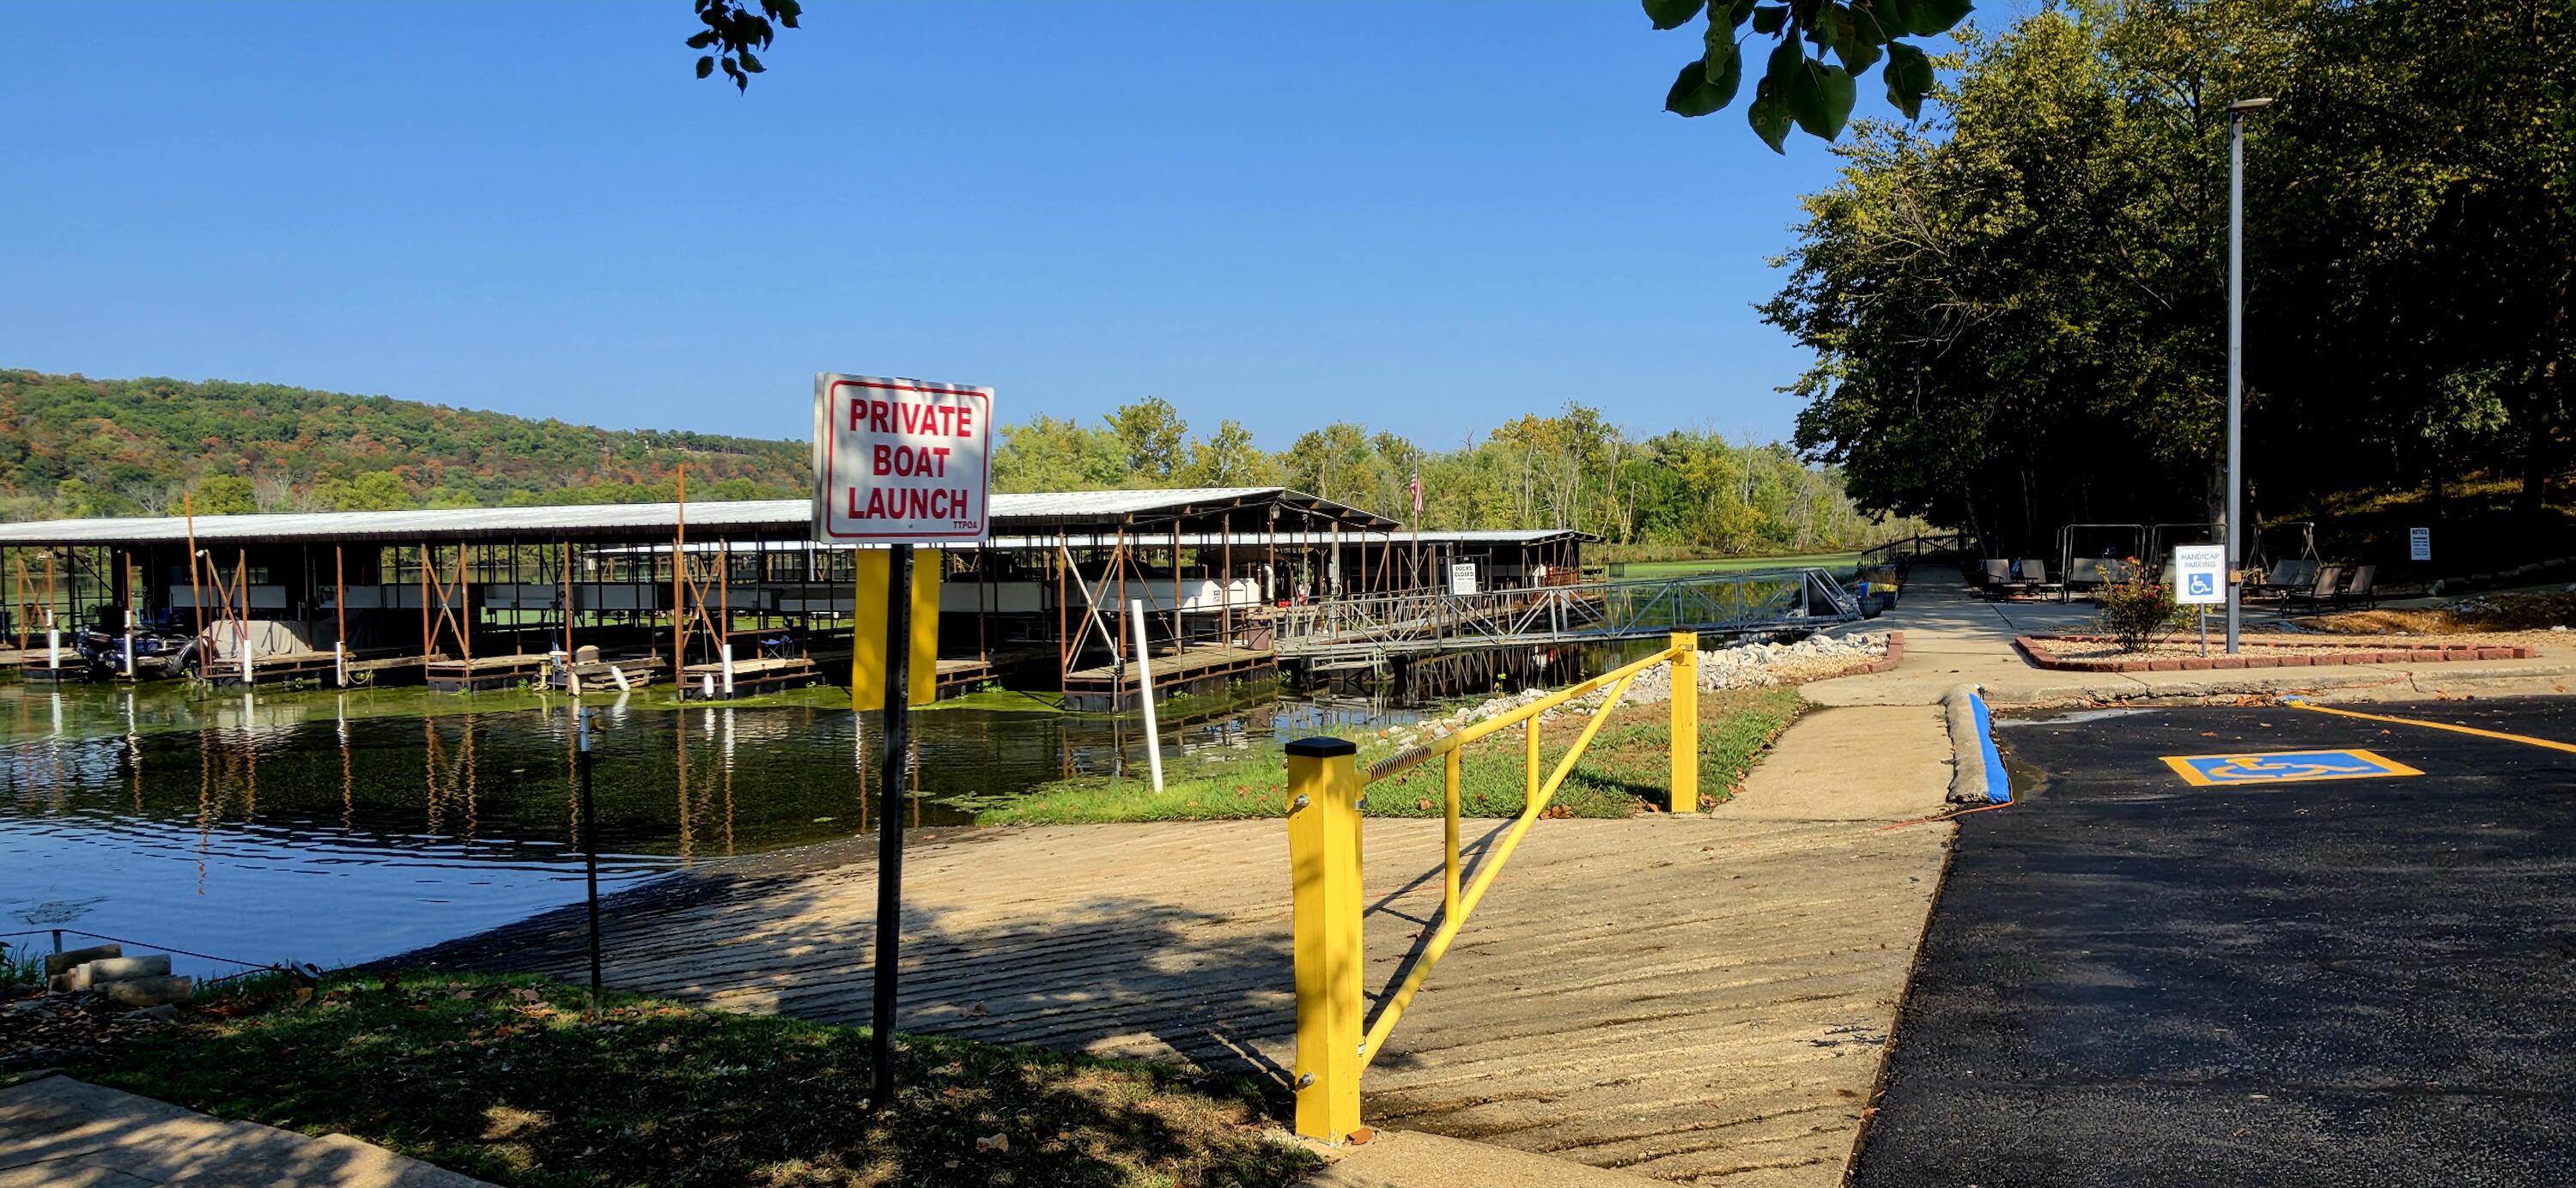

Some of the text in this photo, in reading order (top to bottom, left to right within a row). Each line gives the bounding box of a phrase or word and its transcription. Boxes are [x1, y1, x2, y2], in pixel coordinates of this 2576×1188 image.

[850, 398, 972, 437] PRIVATE
[873, 444, 951, 478] BOAT
[848, 487, 968, 519] LAUNCH
